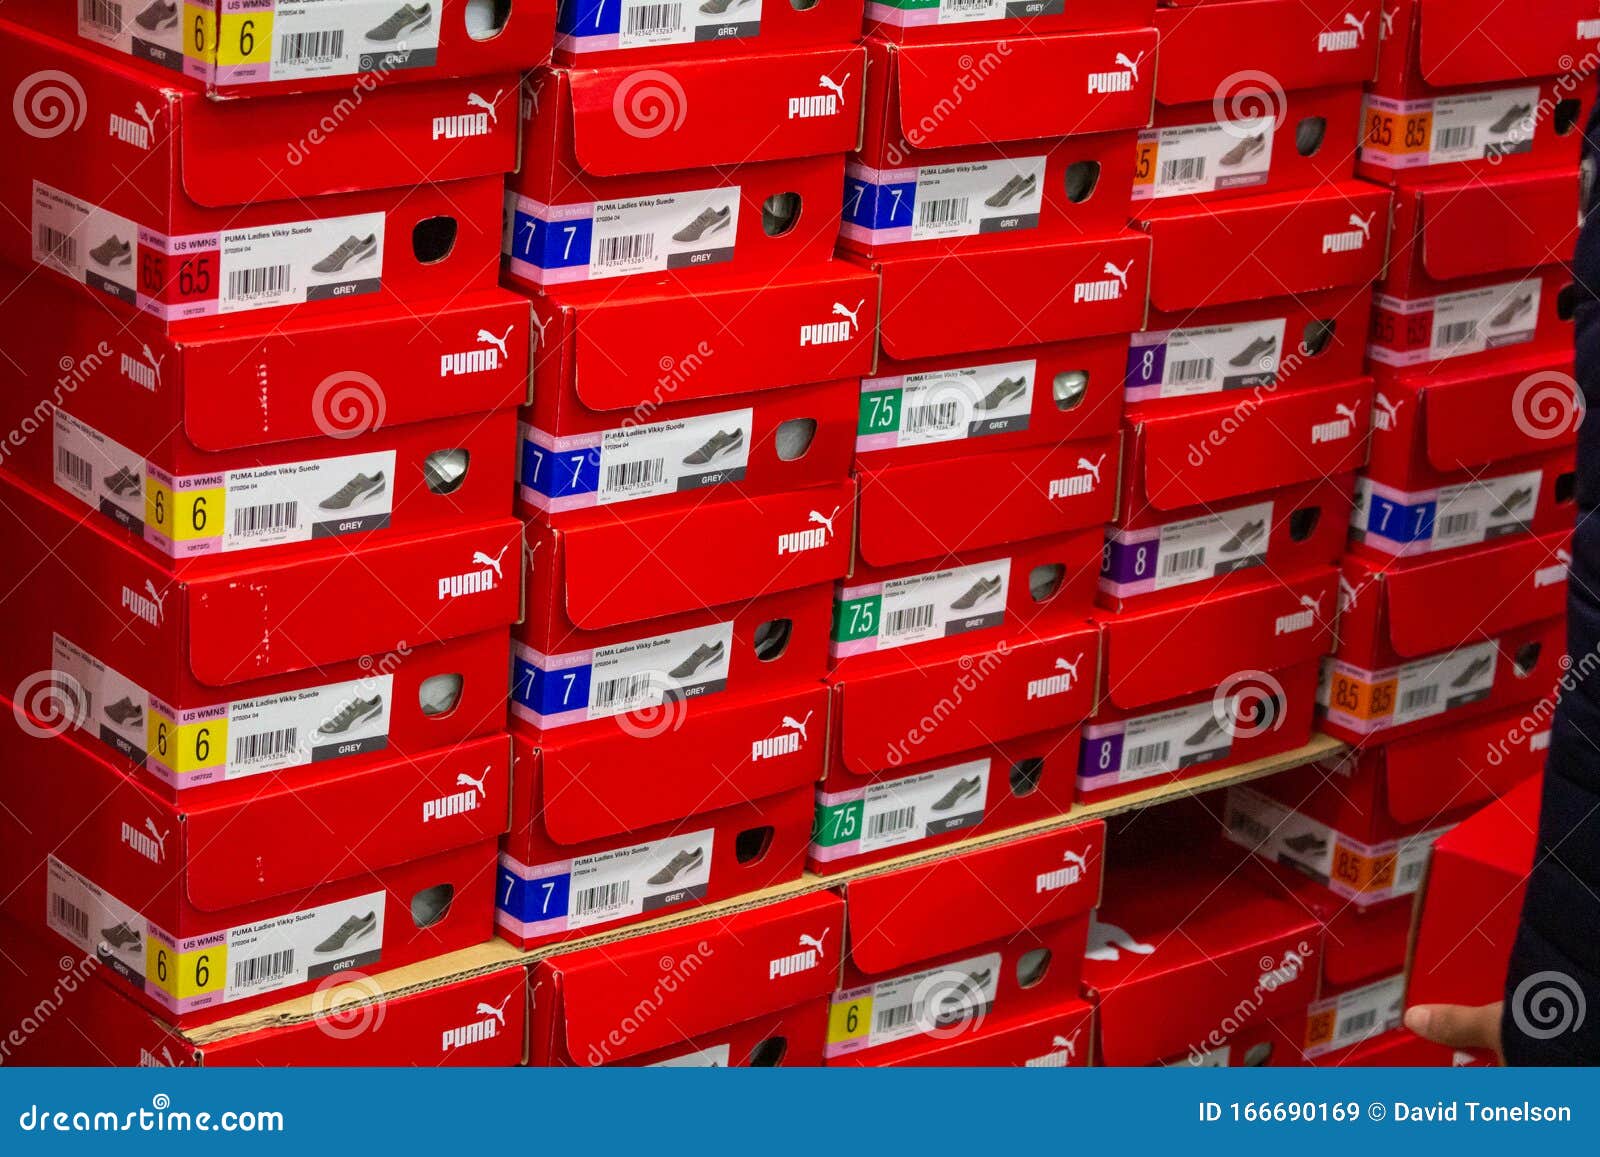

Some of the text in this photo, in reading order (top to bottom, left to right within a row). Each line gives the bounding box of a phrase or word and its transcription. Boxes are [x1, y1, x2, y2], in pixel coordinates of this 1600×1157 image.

[1025, 4, 1044, 13] GREY
[194, 15, 205, 52] 6
[240, 20, 254, 56] 6
[717, 27, 738, 36] GREY
[1088, 71, 1131, 94] PUMA
[788, 94, 836, 119] PUMA
[110, 114, 148, 150] PUMA
[432, 112, 488, 141] PUMA
[1369, 115, 1393, 146] 8.5
[1405, 118, 1425, 148] 8.5
[920, 168, 937, 176] PUMA
[938, 167, 955, 175] Ladies
[956, 166, 971, 174] Vikky
[596, 198, 675, 212] PUMA Ladies Vikky Suede
[853, 185, 865, 217] 7
[890, 190, 903, 221] 7
[224, 226, 312, 243] PUMA Ladies Vikky Suede
[1000, 219, 1018, 228] GREY
[174, 238, 217, 251] US WMNS
[525, 221, 536, 255] 7
[563, 227, 577, 260] 7
[690, 253, 712, 263] GREY
[143, 253, 163, 292] 6.5
[179, 259, 210, 296] 6.5
[333, 285, 357, 295] GREY
[1073, 279, 1120, 303] PUMA
[800, 320, 850, 346] PUMA
[121, 353, 155, 392] PUMA
[440, 348, 498, 377] PUMA
[1142, 350, 1154, 380] 8
[906, 375, 924, 383] PUMA
[869, 395, 894, 428] 7.5
[989, 420, 1008, 430] GREY
[626, 428, 646, 438] Ladies
[647, 424, 664, 434] Vikky
[665, 423, 685, 431] Suede
[230, 464, 320, 481] PUMA Ladies Vikky Suede
[533, 450, 543, 484] 7
[571, 455, 585, 488] 7
[701, 474, 723, 484] GREY
[179, 475, 222, 488] US WMNS
[1049, 473, 1093, 500] PUMA
[155, 490, 164, 524] 6
[192, 497, 206, 531] 6
[1381, 503, 1394, 531] 7
[339, 520, 363, 531] GREY
[1415, 508, 1426, 535] 7
[778, 527, 825, 555] PUMA
[1135, 547, 1147, 575] 8
[438, 569, 493, 600] PUMA
[122, 586, 157, 626] PUMA
[849, 602, 874, 635] 7.5
[965, 618, 984, 628] GREY
[595, 638, 671, 658] PUMA Ladies Vikky Suede
[525, 669, 535, 700] 7
[563, 673, 576, 705] 7
[685, 686, 706, 697] GREY
[1027, 673, 1070, 700] PUMA
[1336, 679, 1359, 711] 8.5
[183, 707, 225, 721] US WMNS
[232, 691, 319, 712] PUMA Ladies Vikky Suede
[158, 722, 167, 757] 6
[195, 728, 209, 761] 6
[338, 742, 362, 754] GREY
[752, 732, 799, 762] PUMA
[1100, 741, 1111, 769] 8
[423, 790, 476, 823] PUMA
[833, 807, 856, 840] 7.5
[945, 818, 964, 828] GREY
[121, 821, 158, 864] PUMA
[574, 858, 593, 866] PUMA
[614, 849, 630, 859] Vikky
[505, 875, 515, 906] 7
[1036, 865, 1079, 894] PUMA
[541, 882, 555, 914] 7
[665, 892, 685, 903] GREY
[231, 912, 316, 938] PUMA Ladies Vikky Suede
[183, 934, 225, 950] US WMNS
[157, 950, 167, 982] 6
[195, 955, 209, 987] 6
[333, 959, 356, 971] GREY
[769, 949, 816, 980] PUMA
[846, 1005, 858, 1033] 6
[442, 1018, 496, 1051] PUMA
